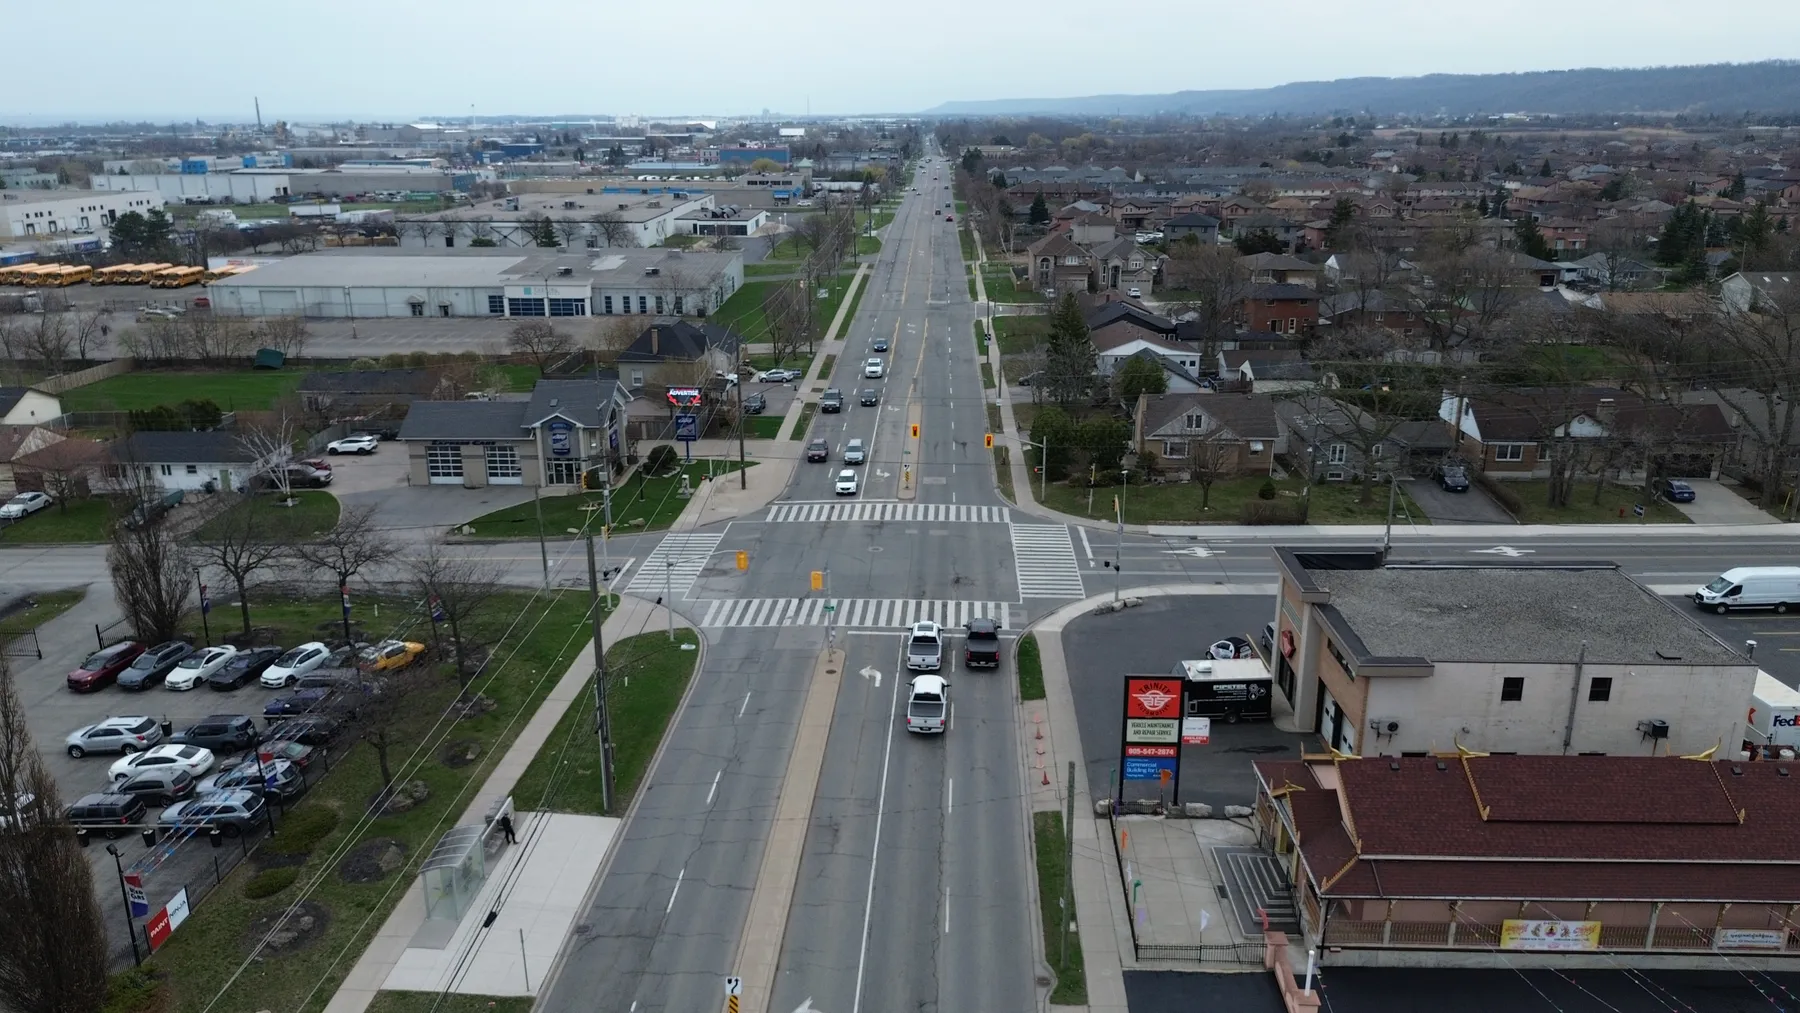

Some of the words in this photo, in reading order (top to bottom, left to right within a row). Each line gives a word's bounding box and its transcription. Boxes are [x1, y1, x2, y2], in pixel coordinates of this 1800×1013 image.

[1139, 682, 1171, 694] TRINITY
[1137, 702, 1170, 716] AUTOMOTIVE
[150, 917, 168, 938] PAINT
